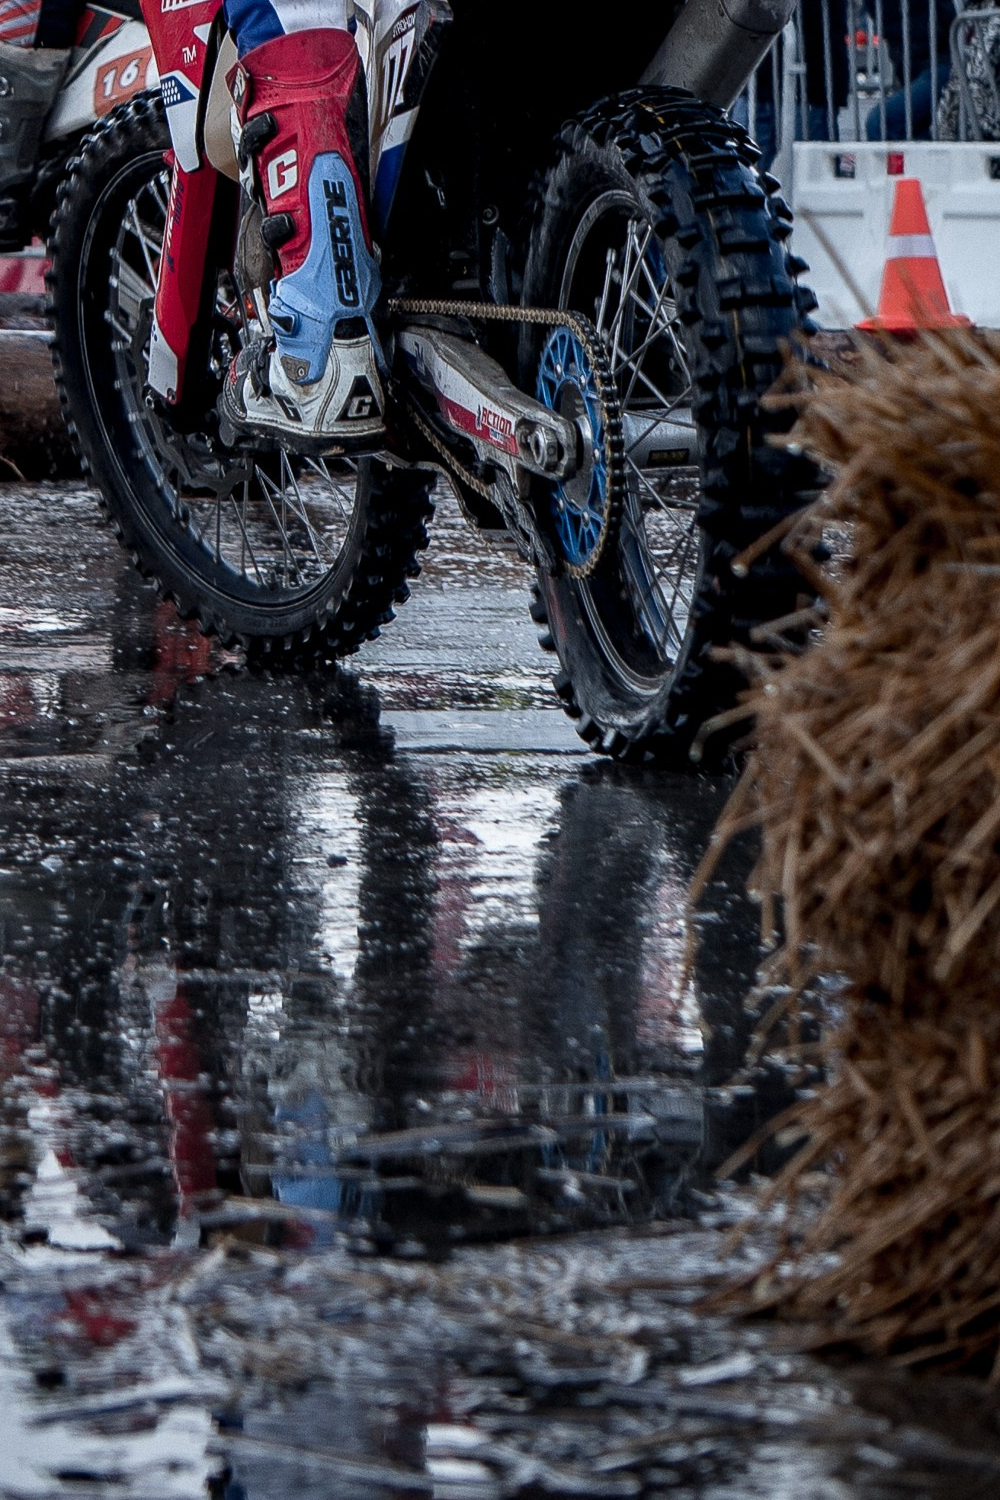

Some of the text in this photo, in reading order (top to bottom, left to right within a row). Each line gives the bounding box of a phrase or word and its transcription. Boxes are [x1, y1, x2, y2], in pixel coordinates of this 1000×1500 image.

[103, 56, 143, 98] 16
[267, 149, 298, 200] G
[481, 405, 512, 438] ACTION
